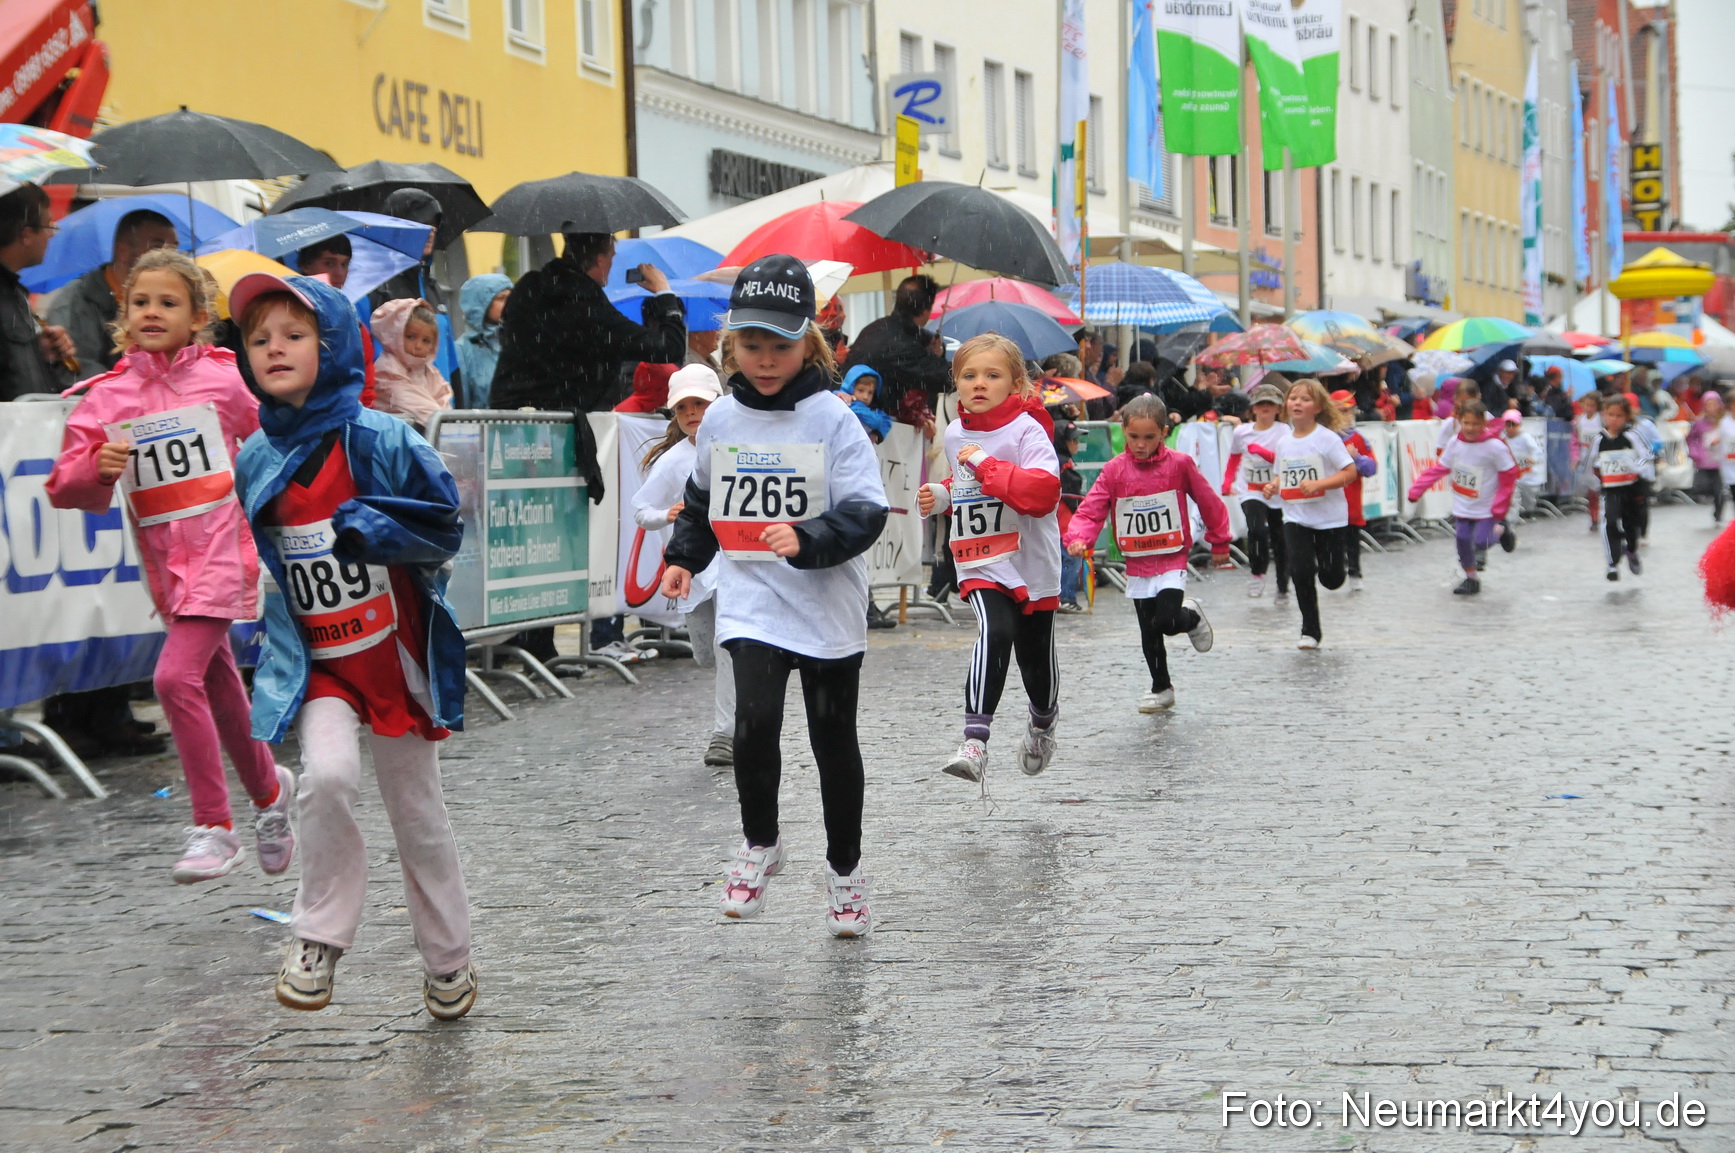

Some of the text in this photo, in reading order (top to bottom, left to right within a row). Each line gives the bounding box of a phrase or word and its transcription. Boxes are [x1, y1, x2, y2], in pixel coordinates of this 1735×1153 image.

[371, 72, 483, 158] CAFE DELI
[740, 281, 800, 303] MELANIE
[132, 416, 181, 438] BOCK
[129, 433, 212, 487] 7191
[736, 452, 781, 466] BOCK
[721, 475, 808, 518] 7265
[489, 499, 507, 528] Fun
[508, 498, 516, 527] &
[516, 496, 544, 526] Action
[1123, 508, 1172, 535] 7001
[282, 531, 326, 551] BOCK
[738, 529, 761, 543] Mela
[1133, 538, 1168, 549] Nadine
[490, 538, 526, 568] sicheren
[956, 543, 991, 558] aria
[283, 560, 371, 611] 089
[302, 617, 363, 643] amara
